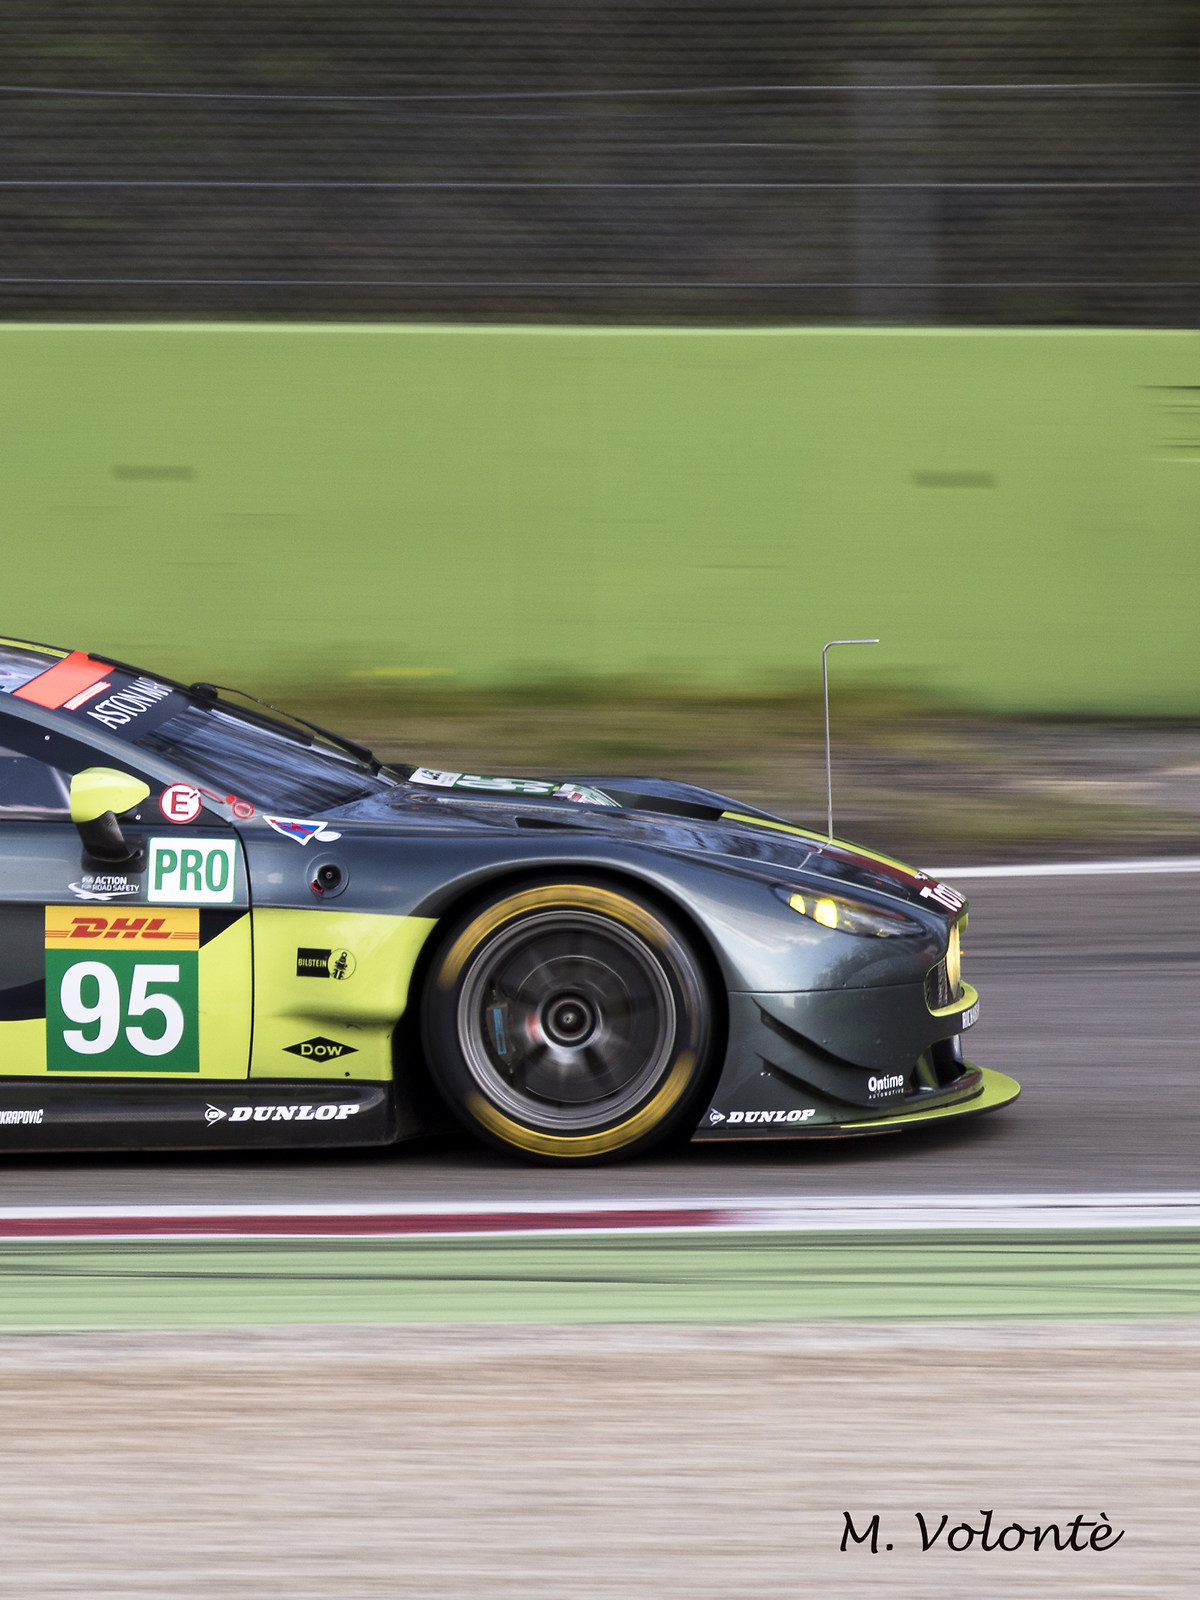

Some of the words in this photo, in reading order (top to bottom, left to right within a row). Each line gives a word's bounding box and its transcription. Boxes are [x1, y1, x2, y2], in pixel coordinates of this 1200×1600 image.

[87, 692, 157, 730] ASTON
[154, 849, 229, 892] PRO
[92, 884, 113, 892] ROAD
[112, 884, 140, 892] SAFETY
[94, 876, 127, 885] ACTION
[69, 917, 174, 940] DHL
[298, 958, 328, 968] BILSTEIN
[59, 961, 185, 1056] 95
[300, 1044, 343, 1056] Dow
[868, 1074, 904, 1092] Ontime
[228, 1104, 360, 1122] DUNLOP
[726, 1109, 816, 1123] DUNLOP
